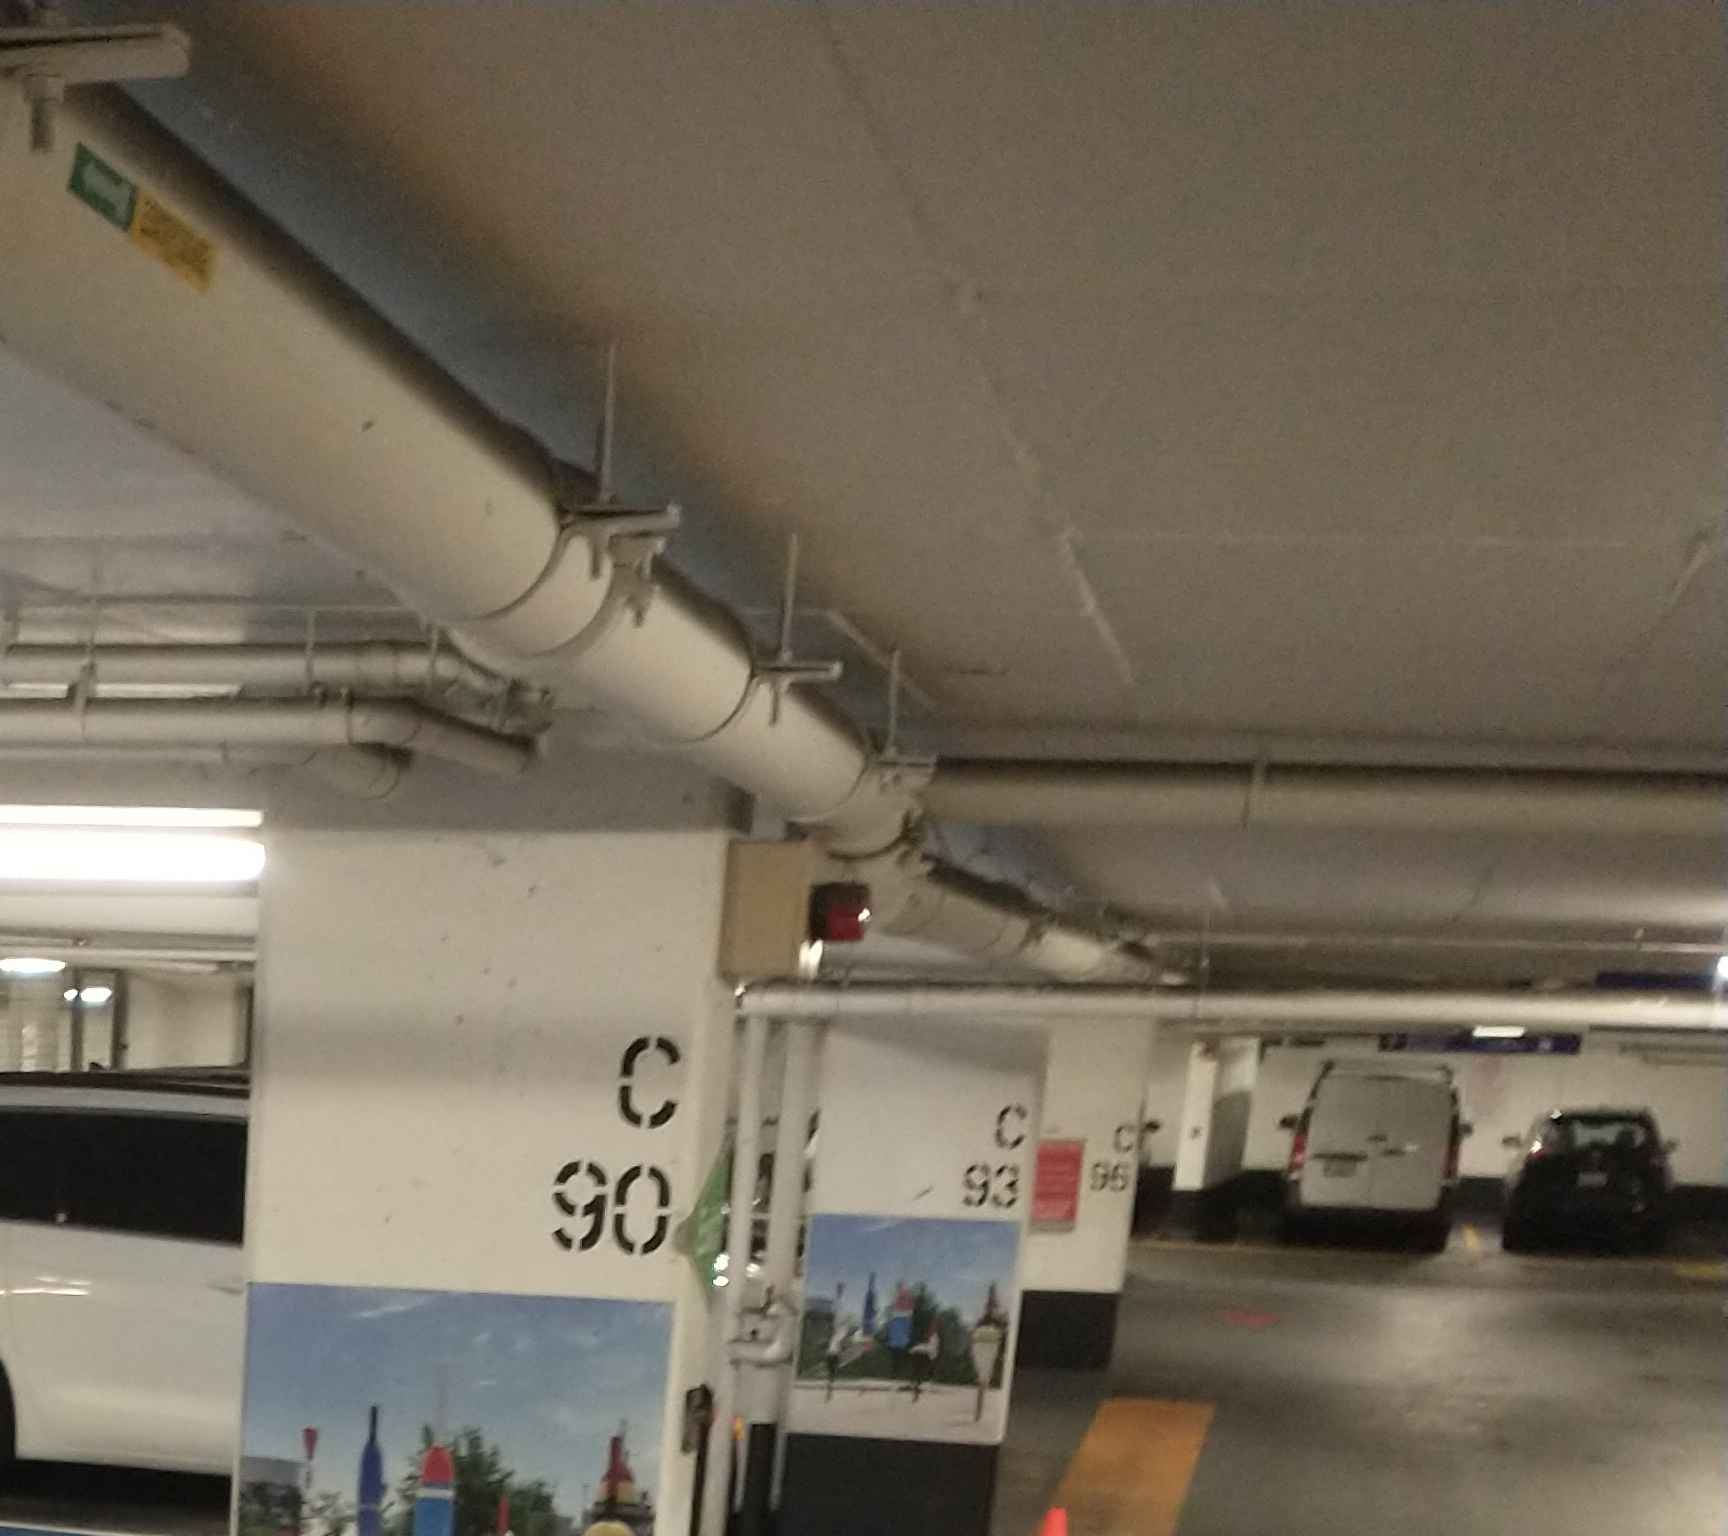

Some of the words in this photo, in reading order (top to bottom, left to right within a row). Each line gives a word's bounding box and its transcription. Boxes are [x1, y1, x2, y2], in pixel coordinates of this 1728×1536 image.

[619, 1036, 680, 1129] C
[995, 1103, 1027, 1149] C
[552, 1160, 670, 1256] 90
[962, 1162, 1020, 1208] 93
